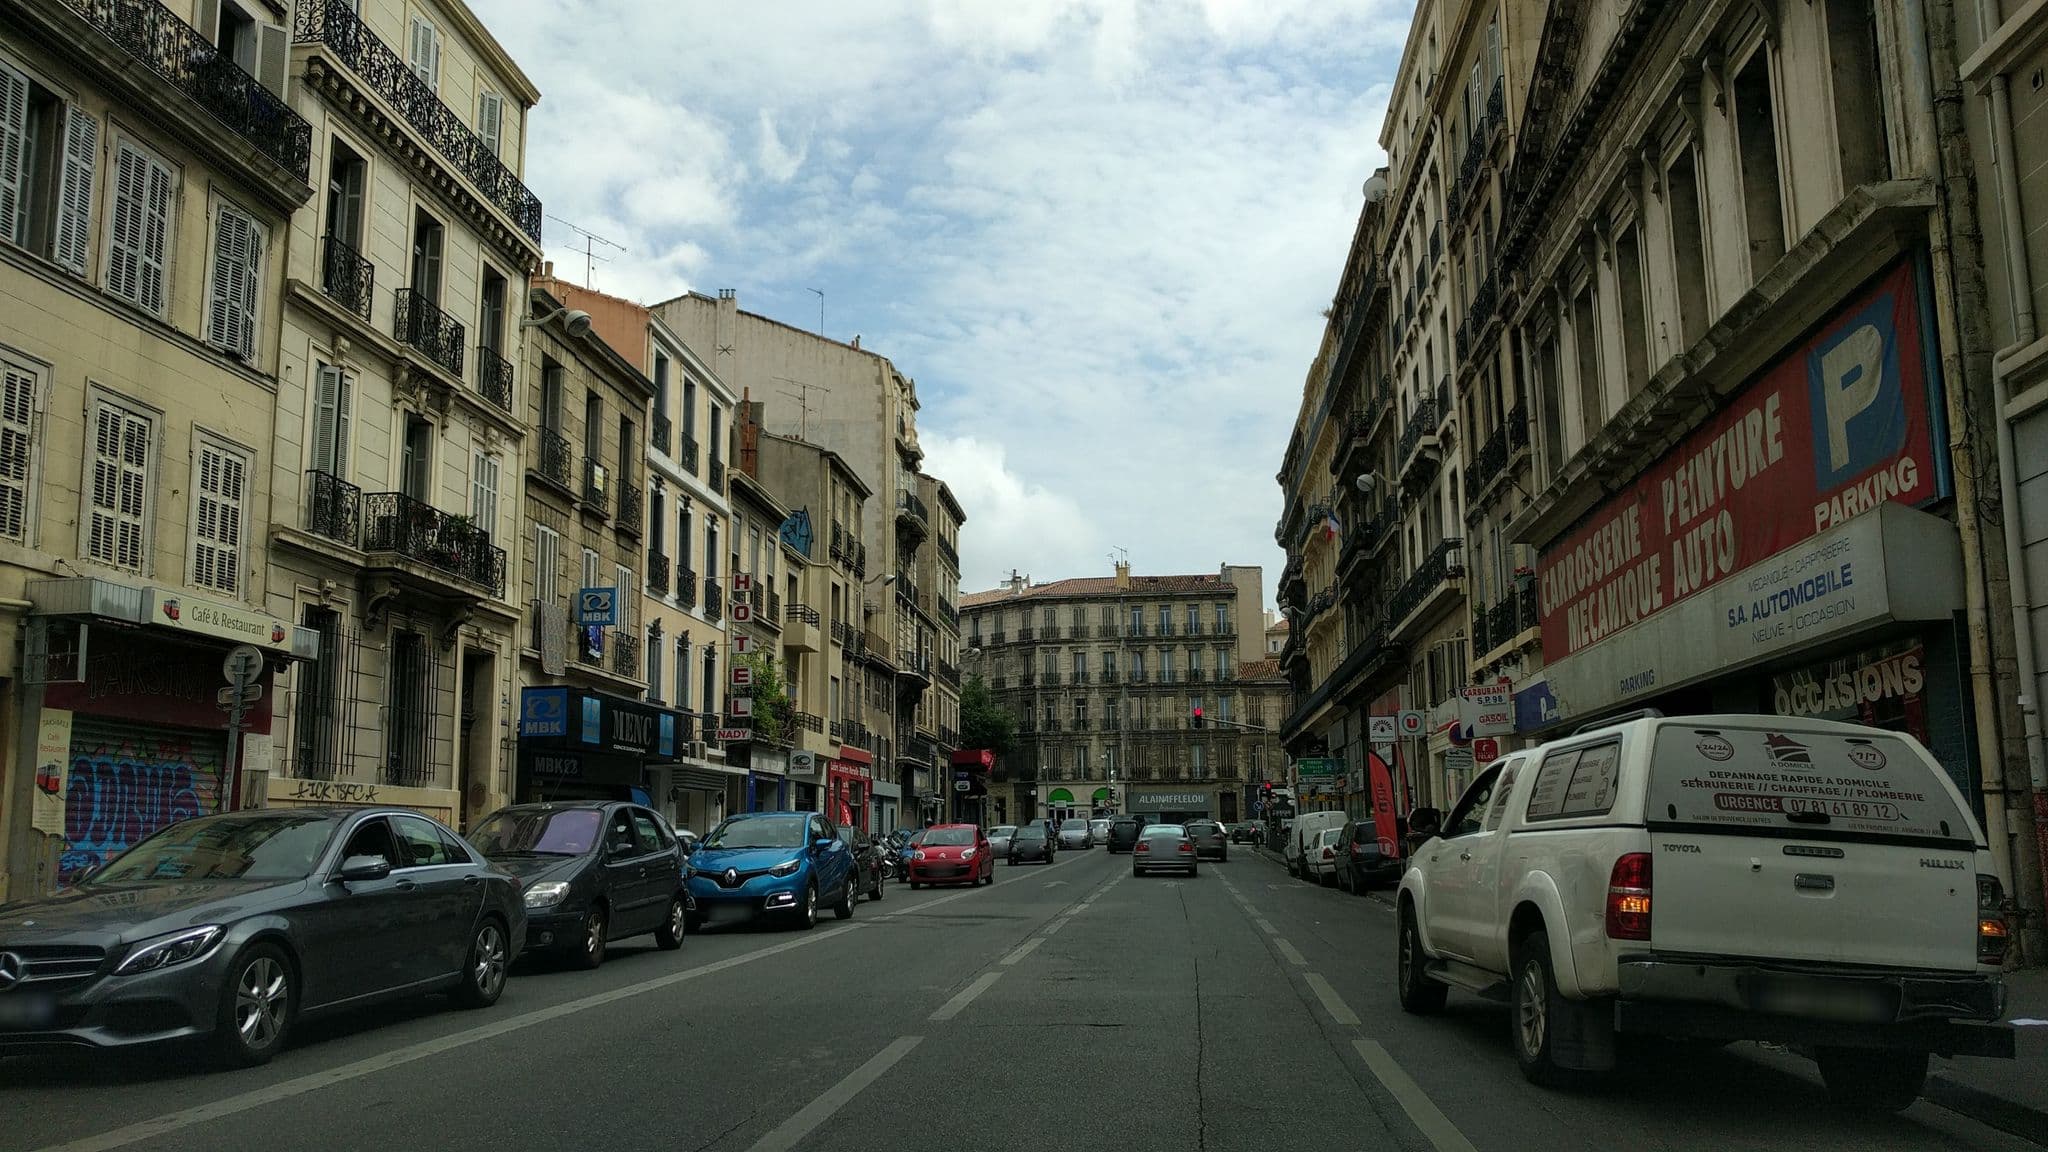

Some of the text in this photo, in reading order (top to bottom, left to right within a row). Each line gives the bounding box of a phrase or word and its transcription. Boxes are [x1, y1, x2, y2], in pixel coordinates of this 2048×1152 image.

[1822, 324, 1882, 472] P
[1541, 392, 1784, 618] CARROSSERIE PEINTURE
[1813, 456, 1919, 534] PARKING
[1567, 509, 1736, 653] MECANIQUE AUTO
[1728, 562, 1853, 628] S.A. AUTOMOBILE
[191, 606, 265, 636] Café & Restaurant
[582, 612, 612, 623] MBK
[1752, 622, 1785, 644] NEUVE
[1795, 596, 1855, 631] OCCASION
[733, 574, 750, 715] HOTEL
[1620, 669, 1655, 695] PARKING
[1774, 655, 1924, 716] OCCASIONS
[525, 721, 561, 734] MBK
[1479, 712, 1509, 724] GASOIL
[717, 729, 748, 739] NADY
[535, 757, 563, 774] MBK
[1681, 779, 1755, 791] SERRURERIE
[1771, 784, 1841, 796] CHAUFFAGE
[1857, 789, 1925, 802] PLOMBERIE
[1709, 770, 1891, 789] DEPANNAGE RAPIDE A DOMICILE
[1719, 795, 1891, 818] URGENCE 07 81 61 89 12
[1663, 844, 1701, 853] TOYOTA
[1920, 858, 1965, 870] HILUX
